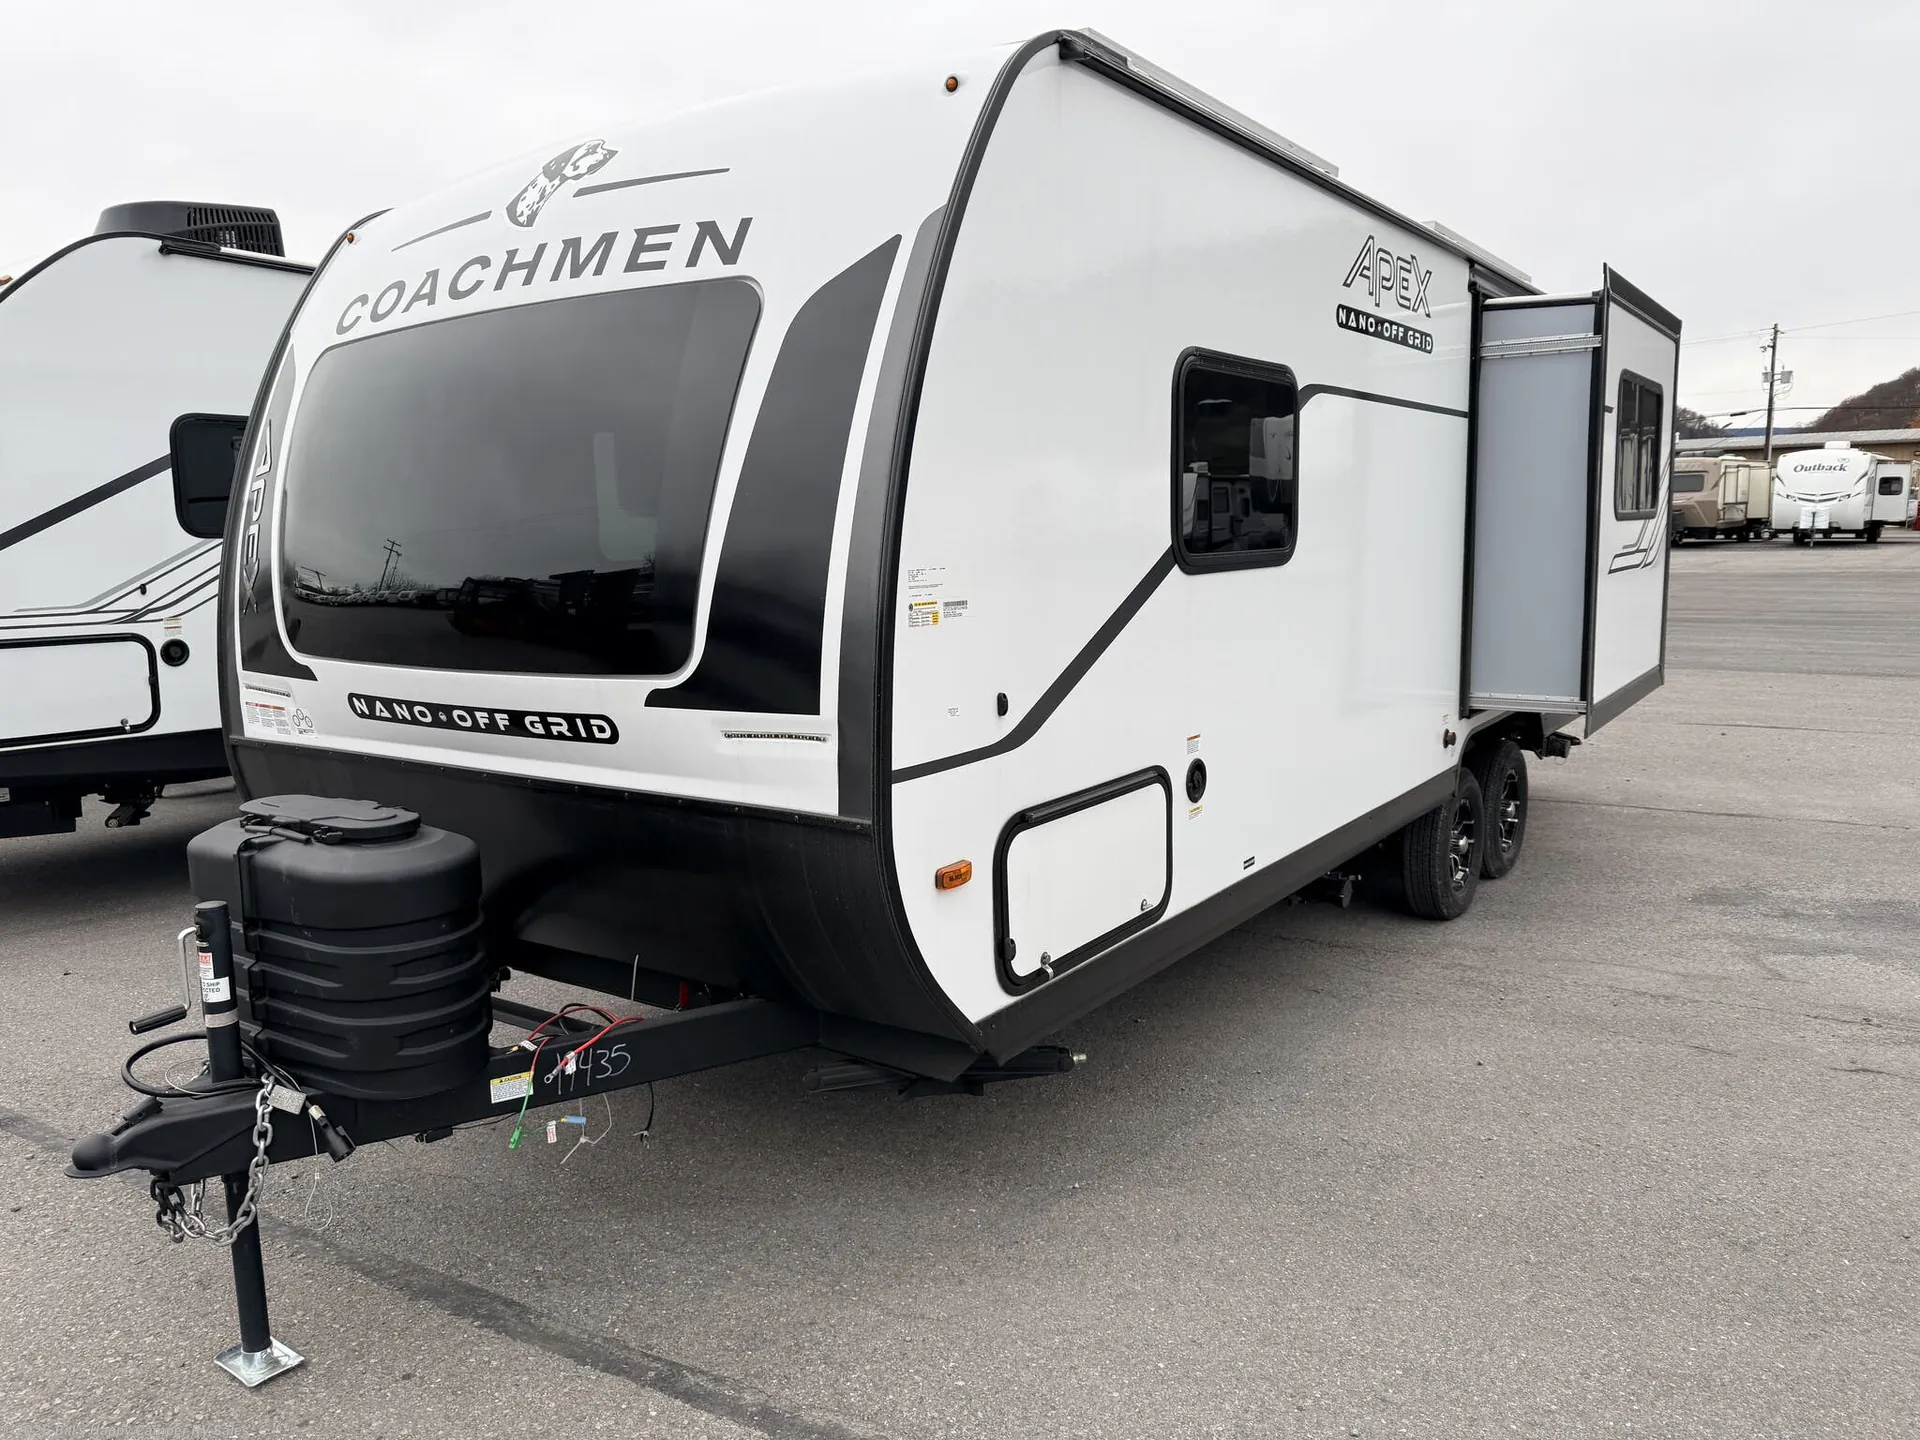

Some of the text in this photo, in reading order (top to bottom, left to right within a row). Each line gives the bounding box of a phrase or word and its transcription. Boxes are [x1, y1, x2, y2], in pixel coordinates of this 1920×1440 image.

[335, 216, 753, 336] COACHMEN
[1342, 234, 1432, 318] APEX
[1339, 307, 1432, 351] NANO OFF GRID
[1793, 463, 1848, 473] Outback
[243, 419, 273, 615] APEX
[352, 697, 612, 739] NANO OFF GRID
